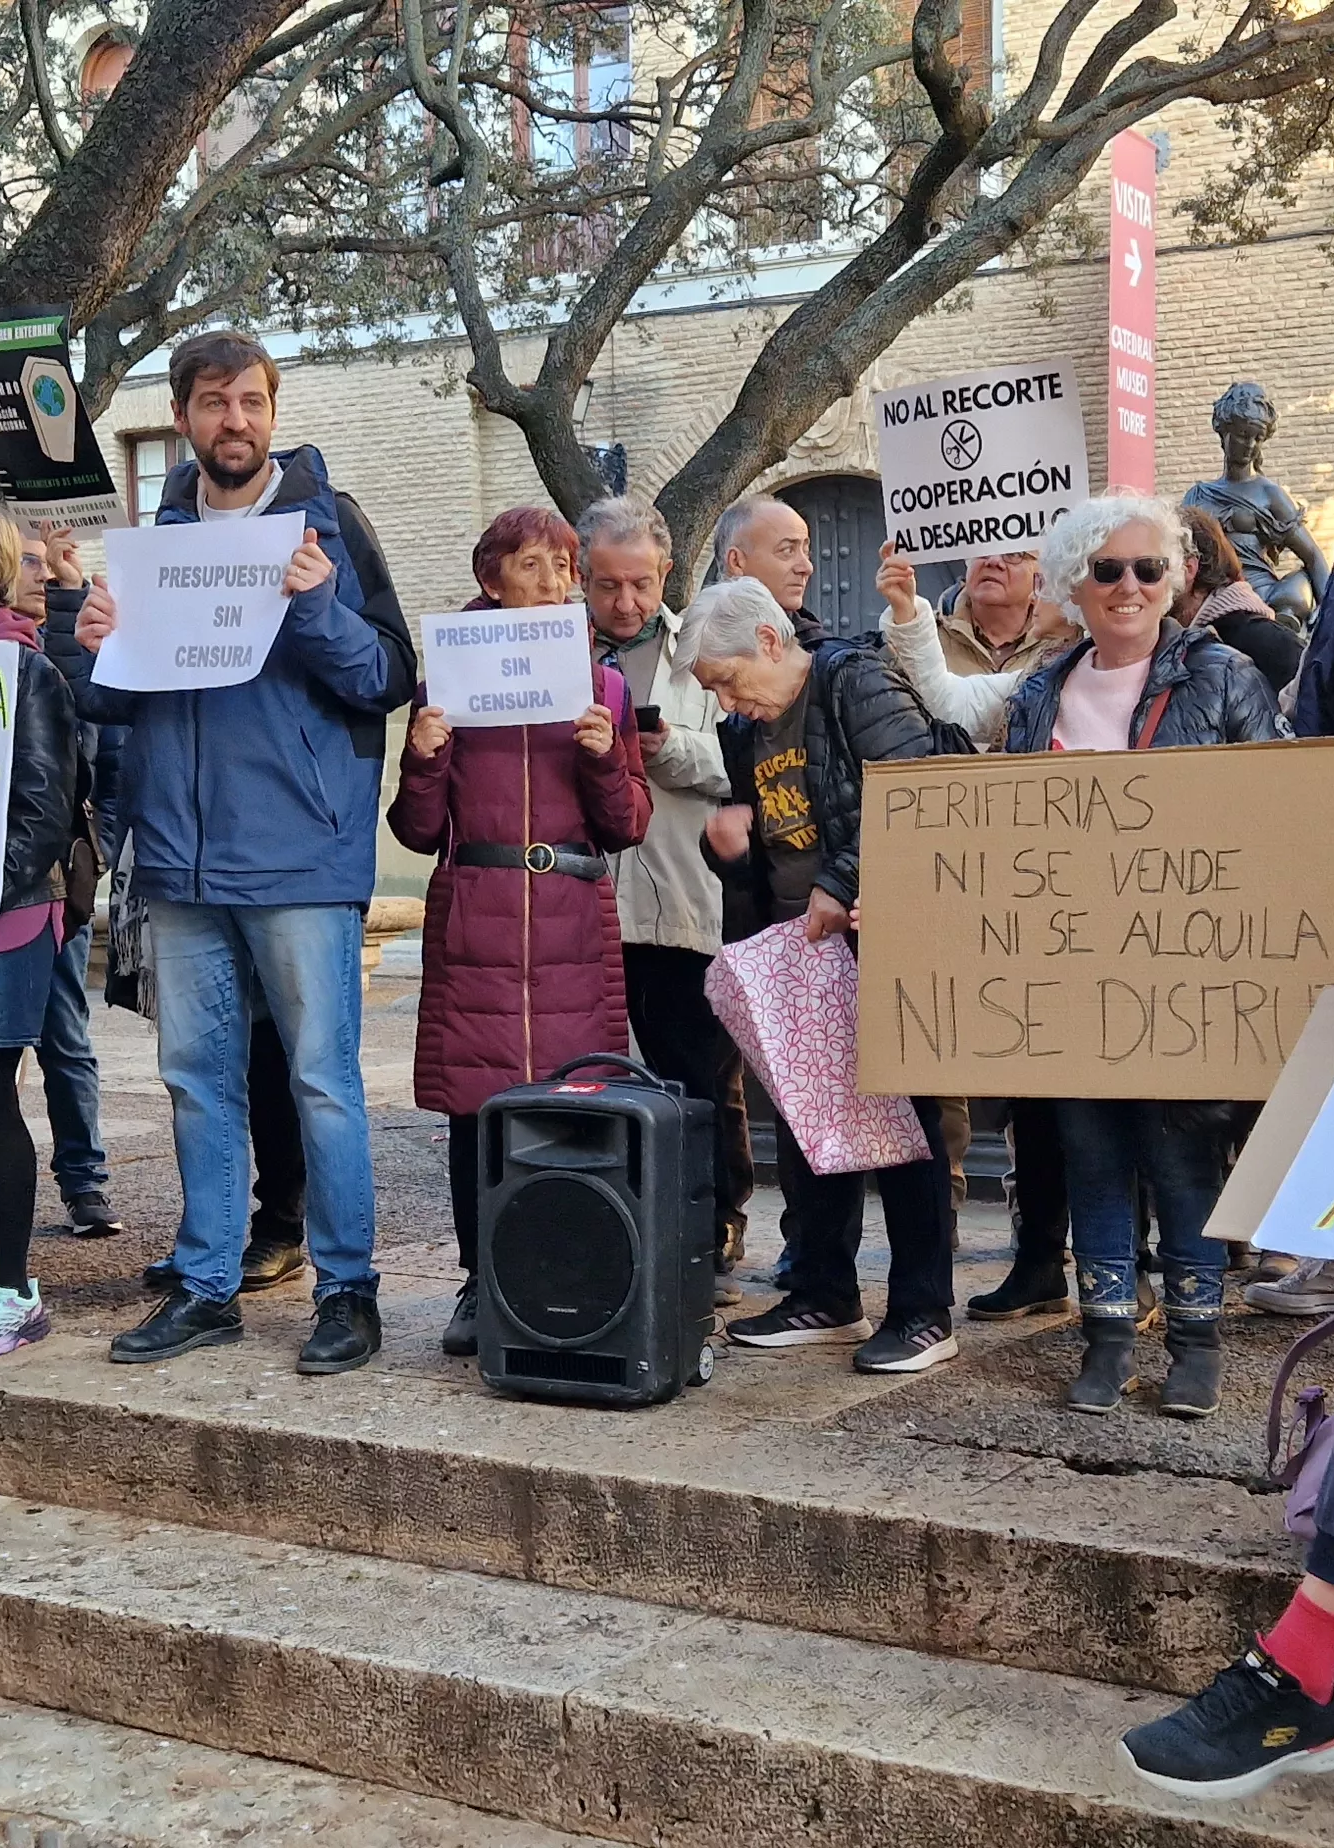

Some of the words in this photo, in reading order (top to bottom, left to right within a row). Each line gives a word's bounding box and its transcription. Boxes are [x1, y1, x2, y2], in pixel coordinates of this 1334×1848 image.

[1114, 177, 1152, 230] VISITA
[1111, 325, 1153, 362] CATEDRAL
[1117, 366, 1148, 397] MUSEO
[884, 399, 910, 428] NO
[913, 394, 938, 421] AL
[943, 373, 1063, 416] RECORTE
[1117, 407, 1147, 437] TORRE
[890, 459, 1072, 514] COOPERACIÓN
[894, 530, 919, 554] AL
[213, 606, 242, 627] SIN
[435, 619, 575, 647] PRESUPUESTOS
[175, 646, 253, 668] CENSURA
[501, 657, 531, 677] SIN
[469, 690, 554, 713] CENSURA
[886, 774, 1155, 836] PERIFERIAS
[934, 850, 985, 897] NI
[1012, 848, 1072, 898] SE
[1110, 847, 1243, 896] VENDE
[981, 911, 1020, 956] NI
[1044, 910, 1095, 956] SE
[1120, 907, 1329, 962] ALQUILA
[895, 970, 958, 1065] NI
[973, 976, 1064, 1059] SE
